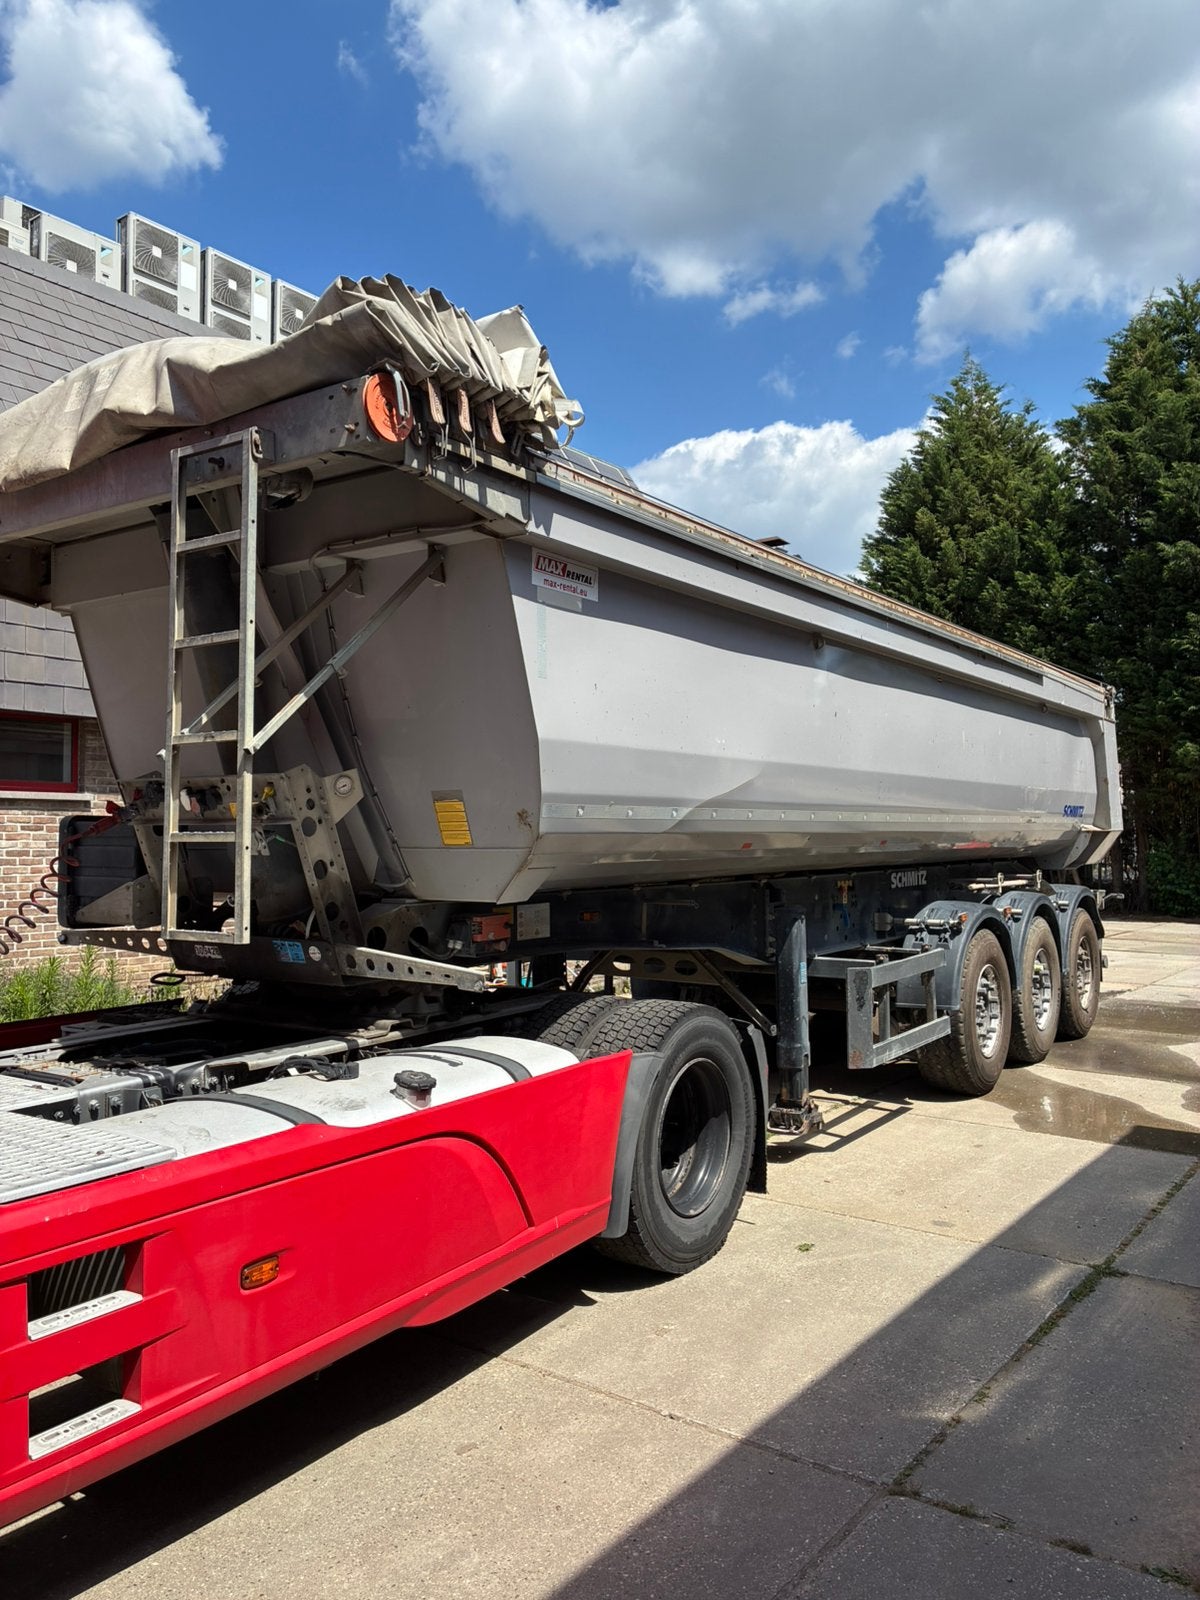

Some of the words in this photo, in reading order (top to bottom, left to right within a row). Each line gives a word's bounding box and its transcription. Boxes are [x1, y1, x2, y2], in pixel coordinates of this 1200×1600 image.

[538, 557, 564, 576] MAX
[566, 570, 593, 585] RENTAL
[543, 578, 588, 597] max-rental.eu
[891, 870, 927, 888] SCHMITZ
